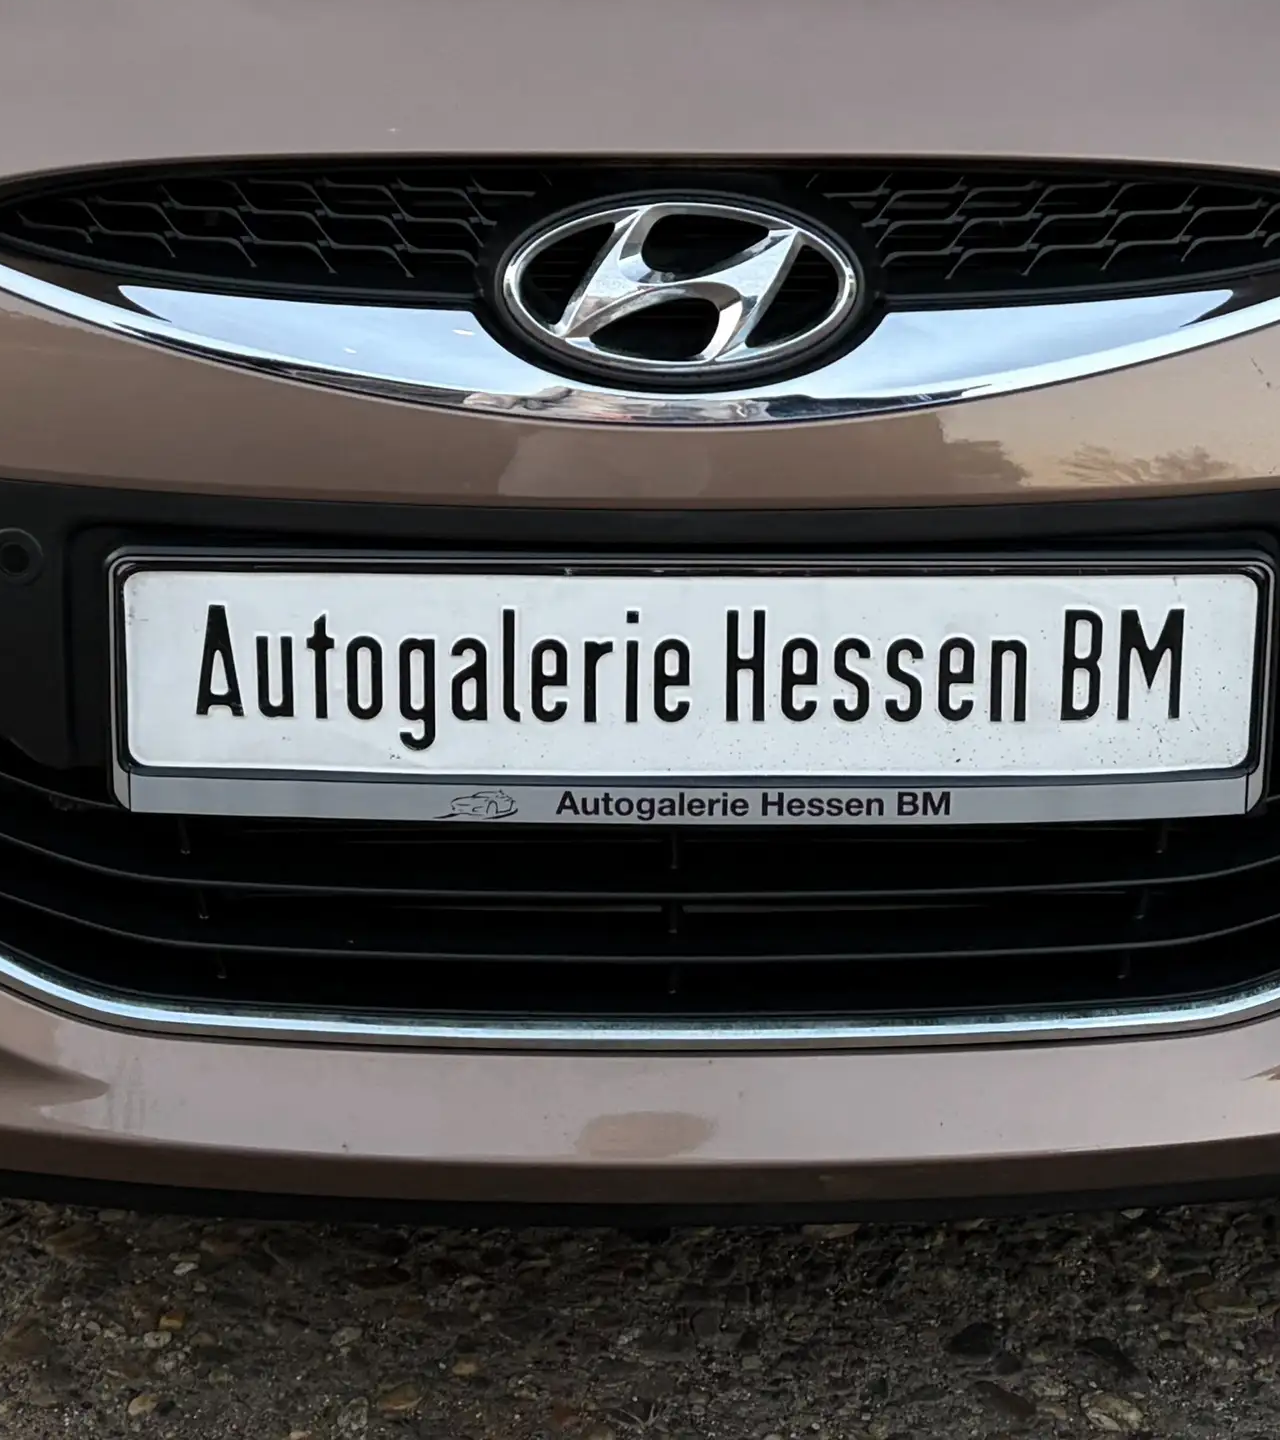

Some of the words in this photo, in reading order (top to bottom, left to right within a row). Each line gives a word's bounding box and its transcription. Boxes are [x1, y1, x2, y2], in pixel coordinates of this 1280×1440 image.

[194, 603, 691, 753] Autogalerie
[724, 608, 1029, 724] Hessen
[1059, 607, 1186, 723] BM
[555, 790, 750, 822] Autogalerie
[761, 790, 885, 818] Hessen
[896, 790, 951, 817] BM
